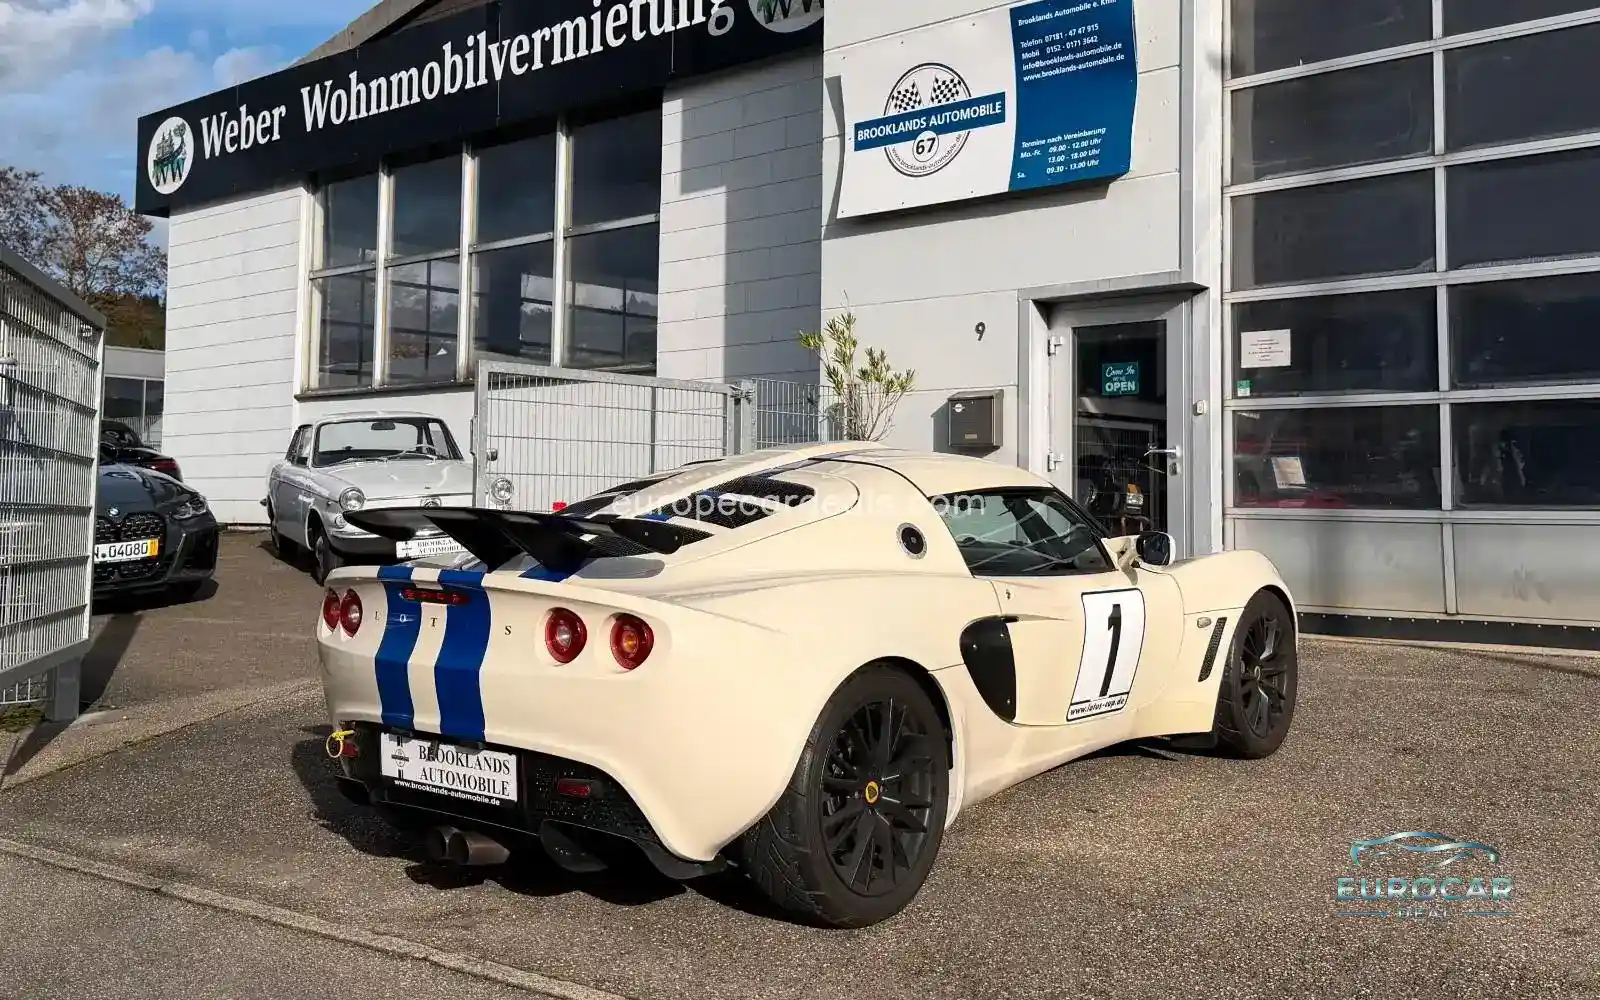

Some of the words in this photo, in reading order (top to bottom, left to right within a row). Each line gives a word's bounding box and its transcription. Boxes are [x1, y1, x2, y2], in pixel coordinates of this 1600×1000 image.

[1018, 12, 1053, 26] Brooklands
[1054, 4, 1091, 18] Automobile
[1020, 38, 1043, 48] Telefon
[1044, 32, 1063, 43] 07181
[1068, 29, 1077, 37] 47
[1077, 26, 1086, 34] 47
[1086, 23, 1099, 32] 915
[1022, 49, 1040, 60] Mobil
[1046, 44, 1062, 54] 0152
[1065, 39, 1081, 49] 0171
[1082, 35, 1099, 46] 3642
[1022, 42, 1122, 71] info@brooklands-automobile.de
[1023, 53, 1125, 82] www.brooklands-automobile.de
[200, 104, 287, 160] Weber
[300, 0, 735, 132] Wohnmobilvermietung
[857, 117, 927, 141] BROOKLANDS
[929, 101, 1002, 127] AUTOMOBILE
[915, 137, 937, 155] 67
[1021, 139, 1046, 148] Termine
[1047, 135, 1062, 143] nach
[1063, 127, 1106, 140] Vereinbarung
[1072, 140, 1089, 149] 12.00
[1089, 138, 1102, 146] Uhr
[1086, 159, 1100, 167] Uhr
[1088, 148, 1101, 156] Uhr
[975, 321, 986, 341] 9
[1105, 380, 1136, 392] OPEN
[108, 542, 148, 558] 04080
[1099, 603, 1122, 697] 1
[1070, 697, 1125, 716] www.lotus-cup.de
[418, 744, 510, 775] BROOKLANDS
[394, 779, 500, 806] www.brooklands-automobile.de
[420, 767, 510, 797] AUTOMOBILE
